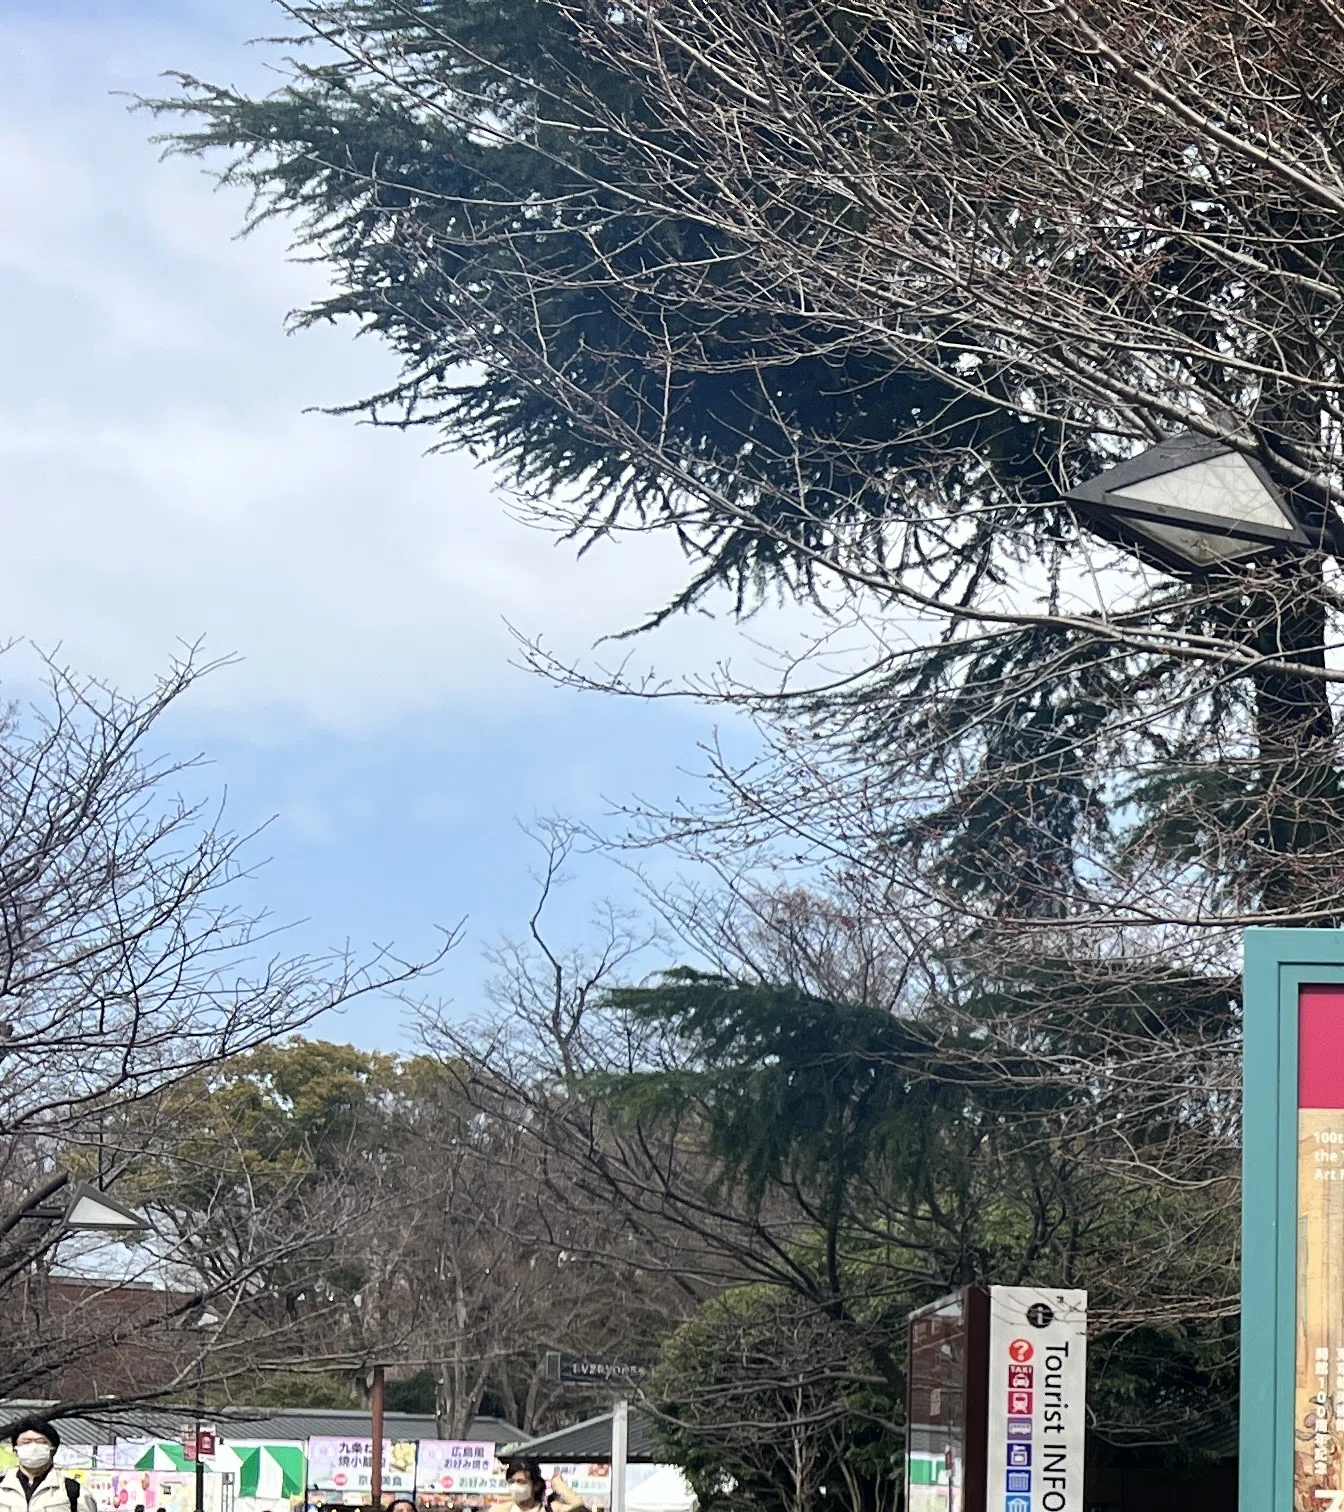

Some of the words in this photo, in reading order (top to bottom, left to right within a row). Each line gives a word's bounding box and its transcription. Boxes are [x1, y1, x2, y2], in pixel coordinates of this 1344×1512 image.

[1314, 1151, 1338, 1162] the
[1314, 1168, 1336, 1180] Art
[1043, 1340, 1070, 1435] Tourist
